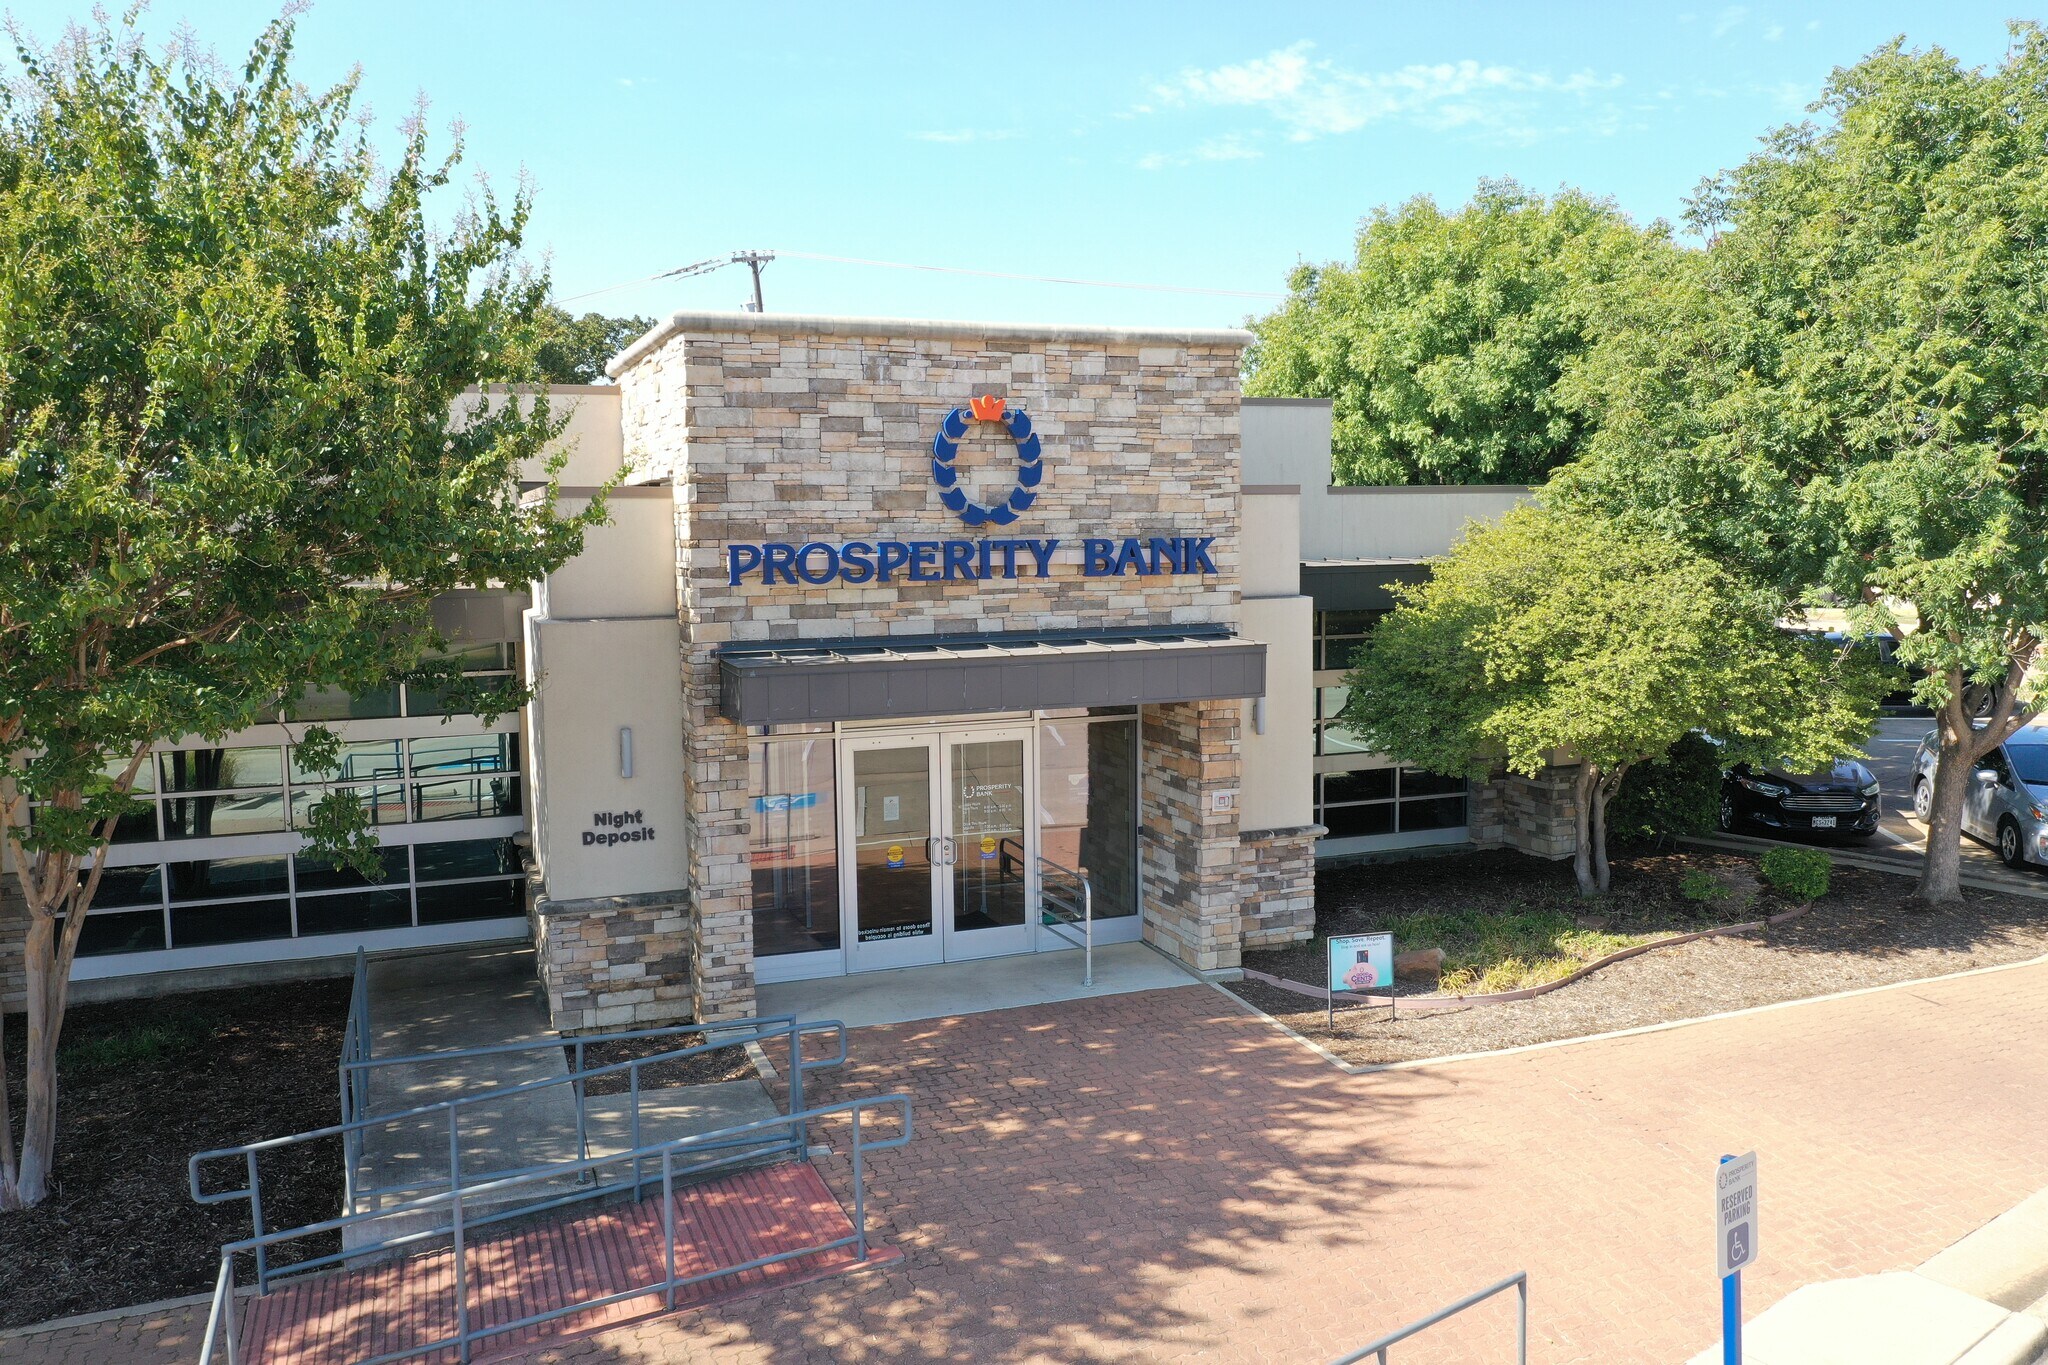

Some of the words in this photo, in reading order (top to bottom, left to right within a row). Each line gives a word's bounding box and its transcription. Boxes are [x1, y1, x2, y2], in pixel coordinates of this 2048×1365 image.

[728, 540, 1060, 586] PROSPERITY
[1083, 537, 1218, 577] BANK
[976, 783, 1012, 791] PROSPERITY
[594, 810, 643, 828] Night
[582, 827, 655, 847] Deposit
[1351, 974, 1373, 983] CENTS
[1728, 1161, 1754, 1177] PROSPERITY
[1728, 1175, 1741, 1186] BANK
[1721, 1185, 1752, 1212] RESERVED
[1724, 1201, 1751, 1226] PARKING
